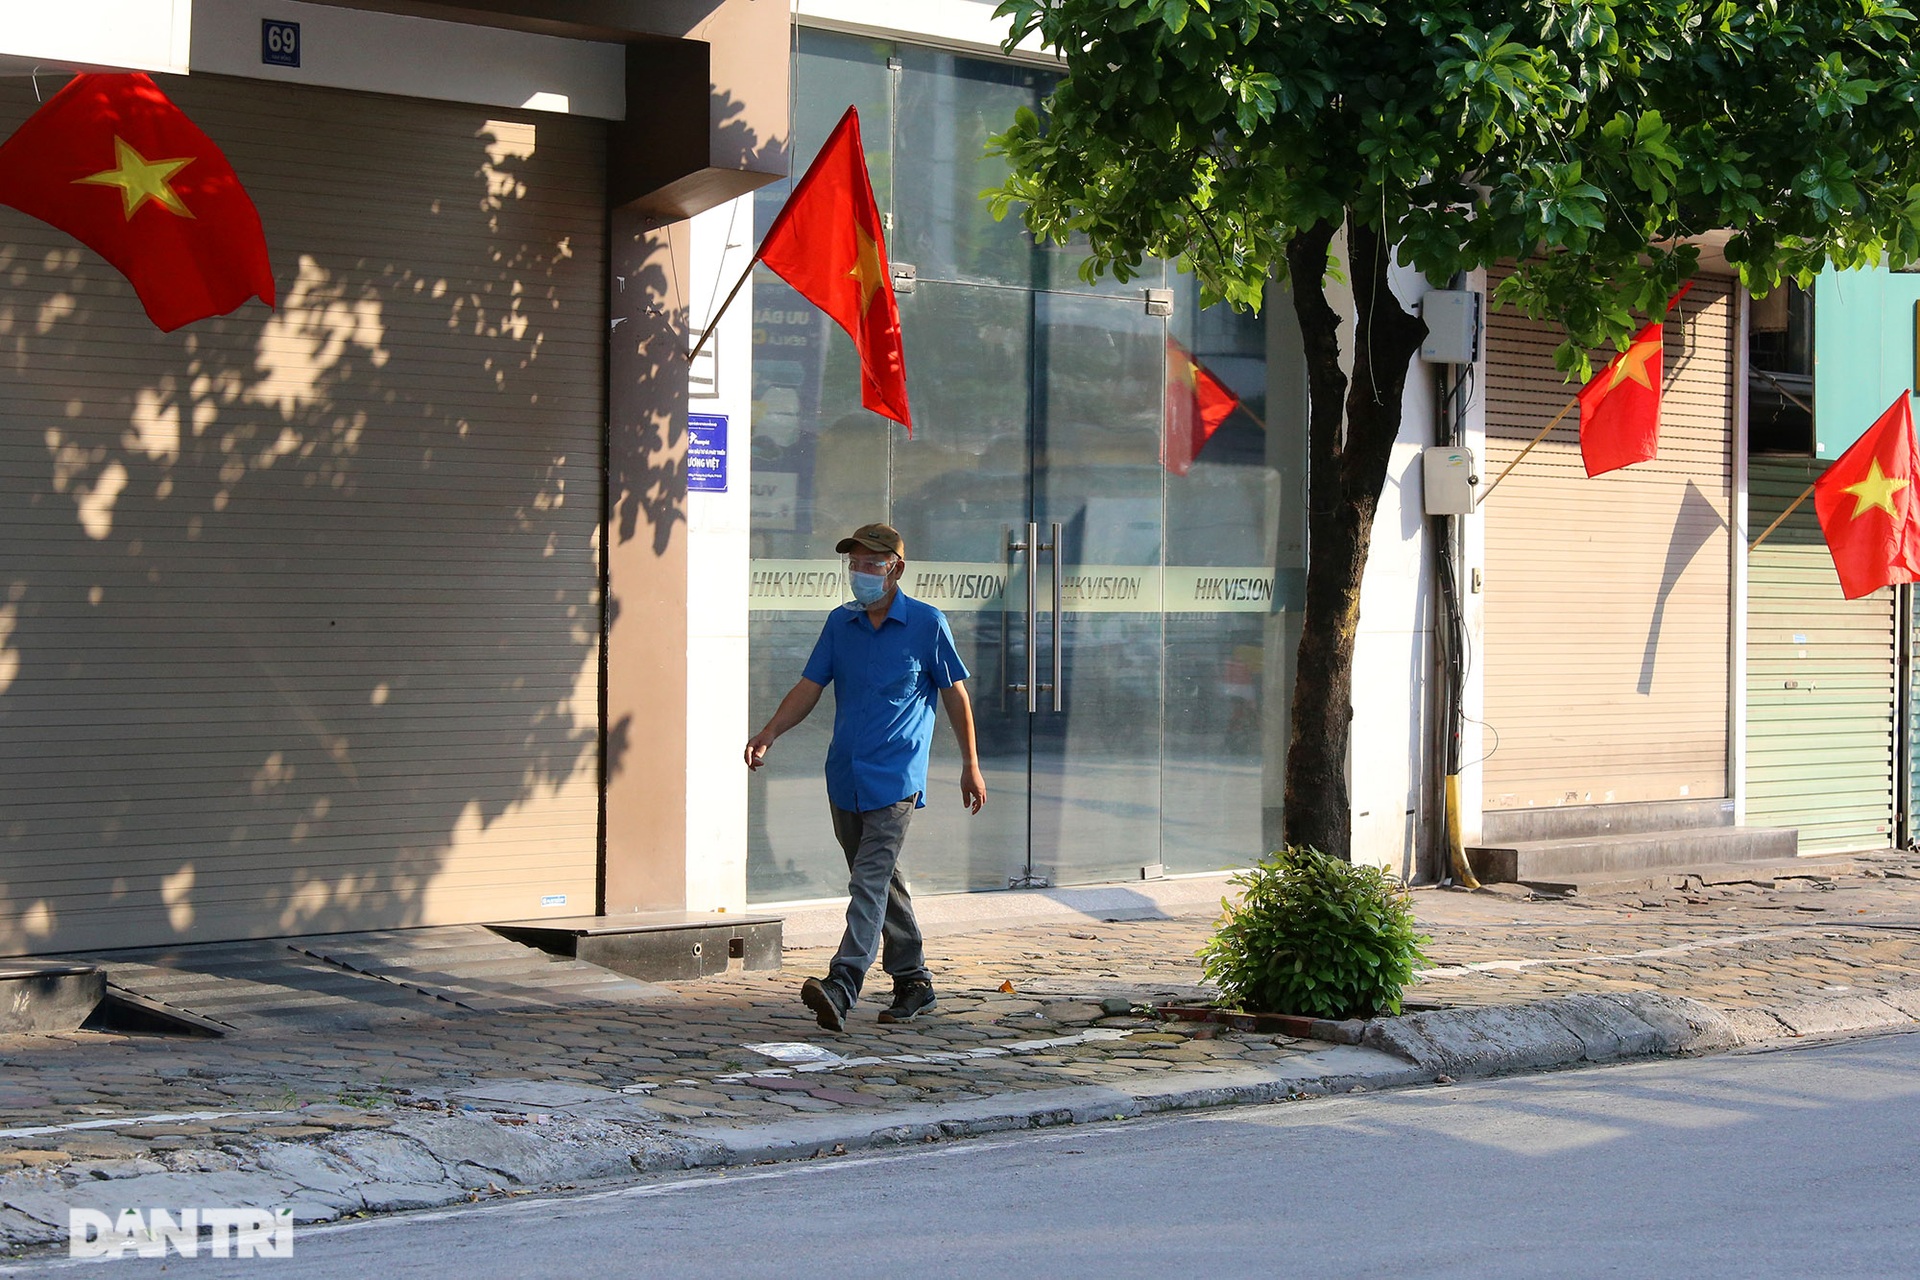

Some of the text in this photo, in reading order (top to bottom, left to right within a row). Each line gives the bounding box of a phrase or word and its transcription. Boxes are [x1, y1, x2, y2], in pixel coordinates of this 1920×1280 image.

[268, 26, 296, 54] 69
[705, 456, 720, 471] VIỆT
[749, 571, 849, 598] HIKVISION
[913, 573, 1007, 600] HIKVISION
[1194, 577, 1275, 601] HIKVISION
